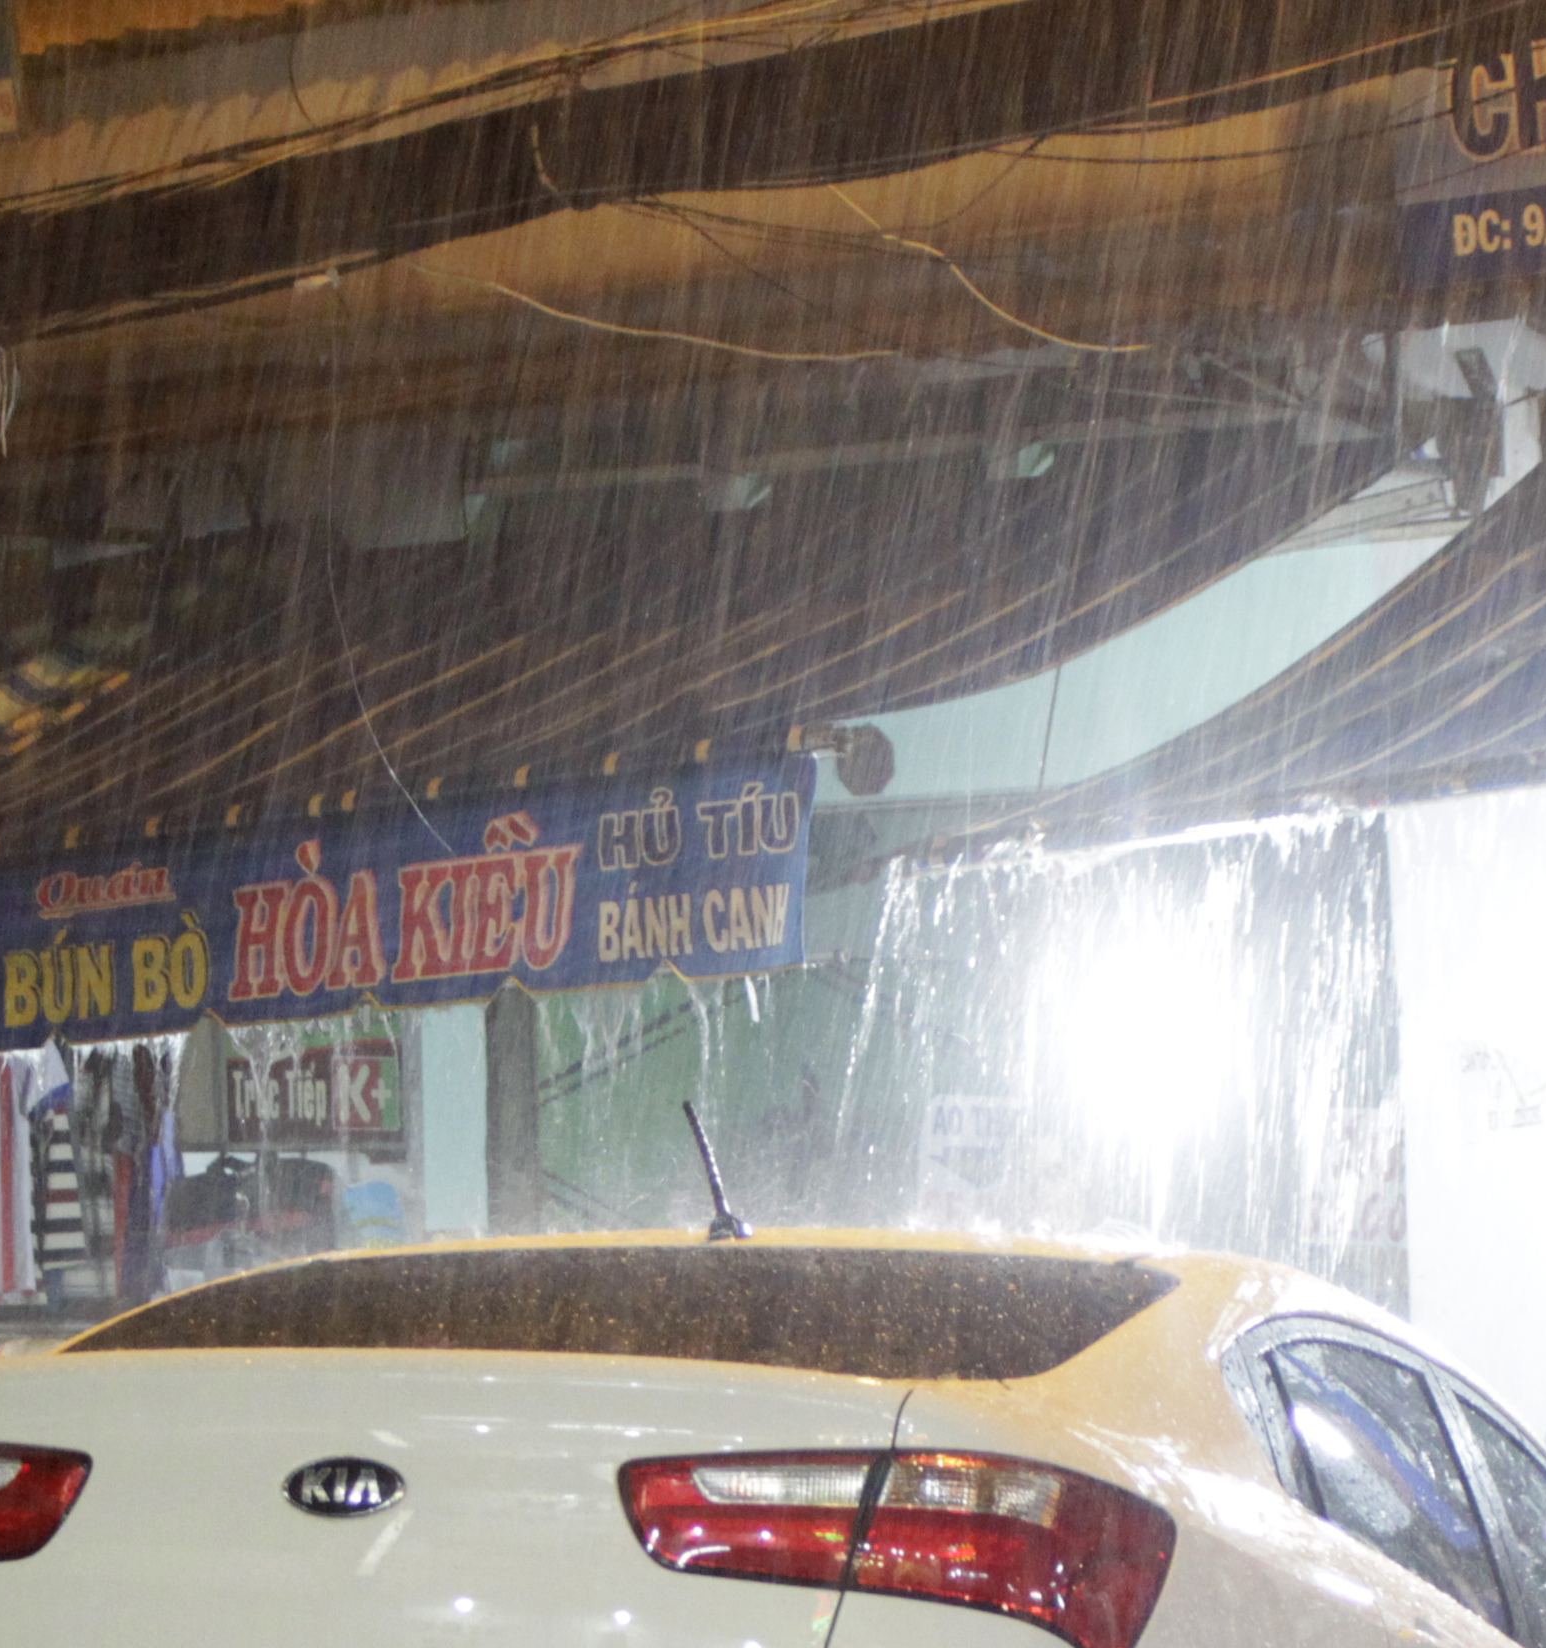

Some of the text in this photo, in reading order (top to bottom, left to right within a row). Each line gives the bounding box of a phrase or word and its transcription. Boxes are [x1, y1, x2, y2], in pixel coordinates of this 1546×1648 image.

[1453, 210, 1512, 256] ĐC:
[598, 782, 800, 871] HỦ TÍU
[229, 811, 583, 1001] HÒA KIỀU
[598, 882, 792, 963] BÁNH CANH
[3, 911, 211, 1028] BÚN BÒ
[337, 1062, 393, 1125] K+
[299, 1466, 384, 1505] KIA
